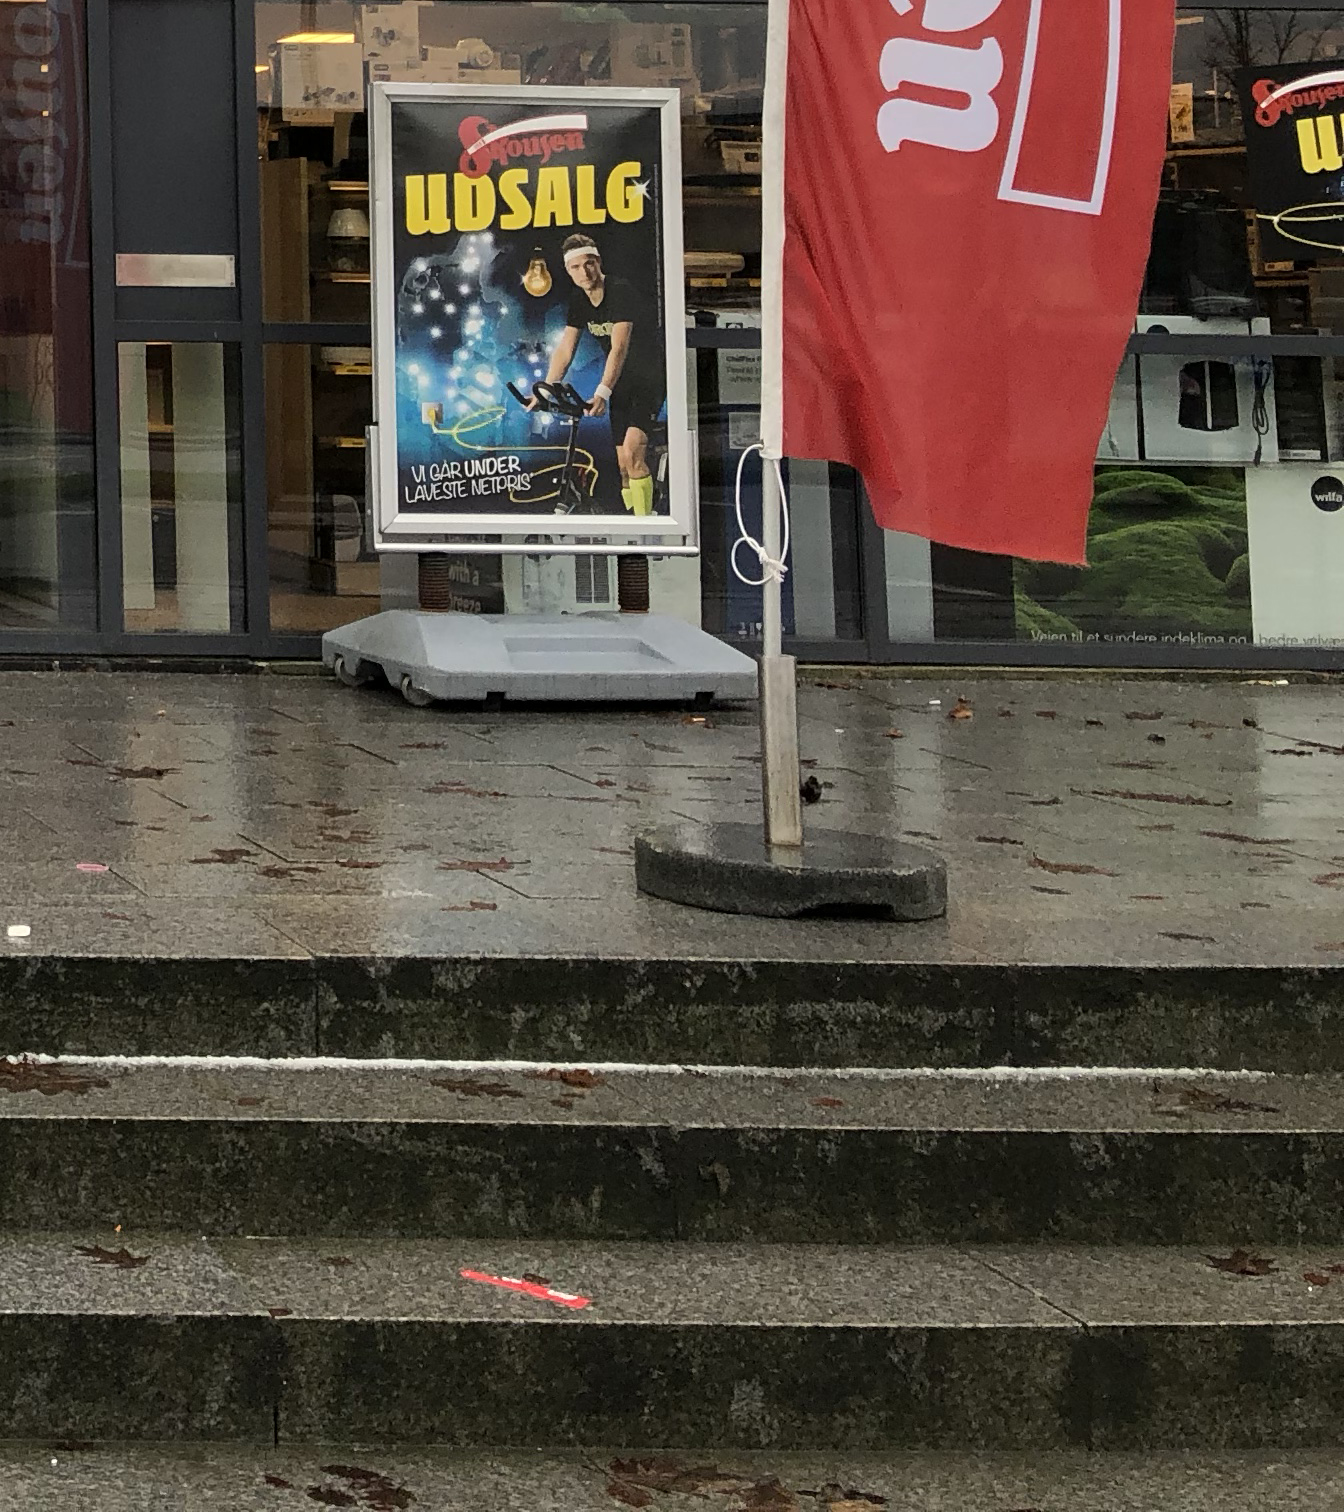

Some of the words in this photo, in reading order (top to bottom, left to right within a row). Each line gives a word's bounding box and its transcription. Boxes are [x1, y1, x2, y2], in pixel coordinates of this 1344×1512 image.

[458, 114, 589, 179] Skousen
[1296, 113, 1344, 174] U
[405, 161, 646, 235] UDSALG
[411, 464, 427, 483] VI
[429, 460, 462, 481] GÅR
[464, 455, 521, 477] UNDER
[405, 479, 469, 504] LAVESTE
[472, 570, 480, 586] a
[1072, 630, 1083, 643] til
[1087, 632, 1100, 642] et
[1104, 631, 1157, 642] sundere
[1162, 631, 1224, 644] indeklima
